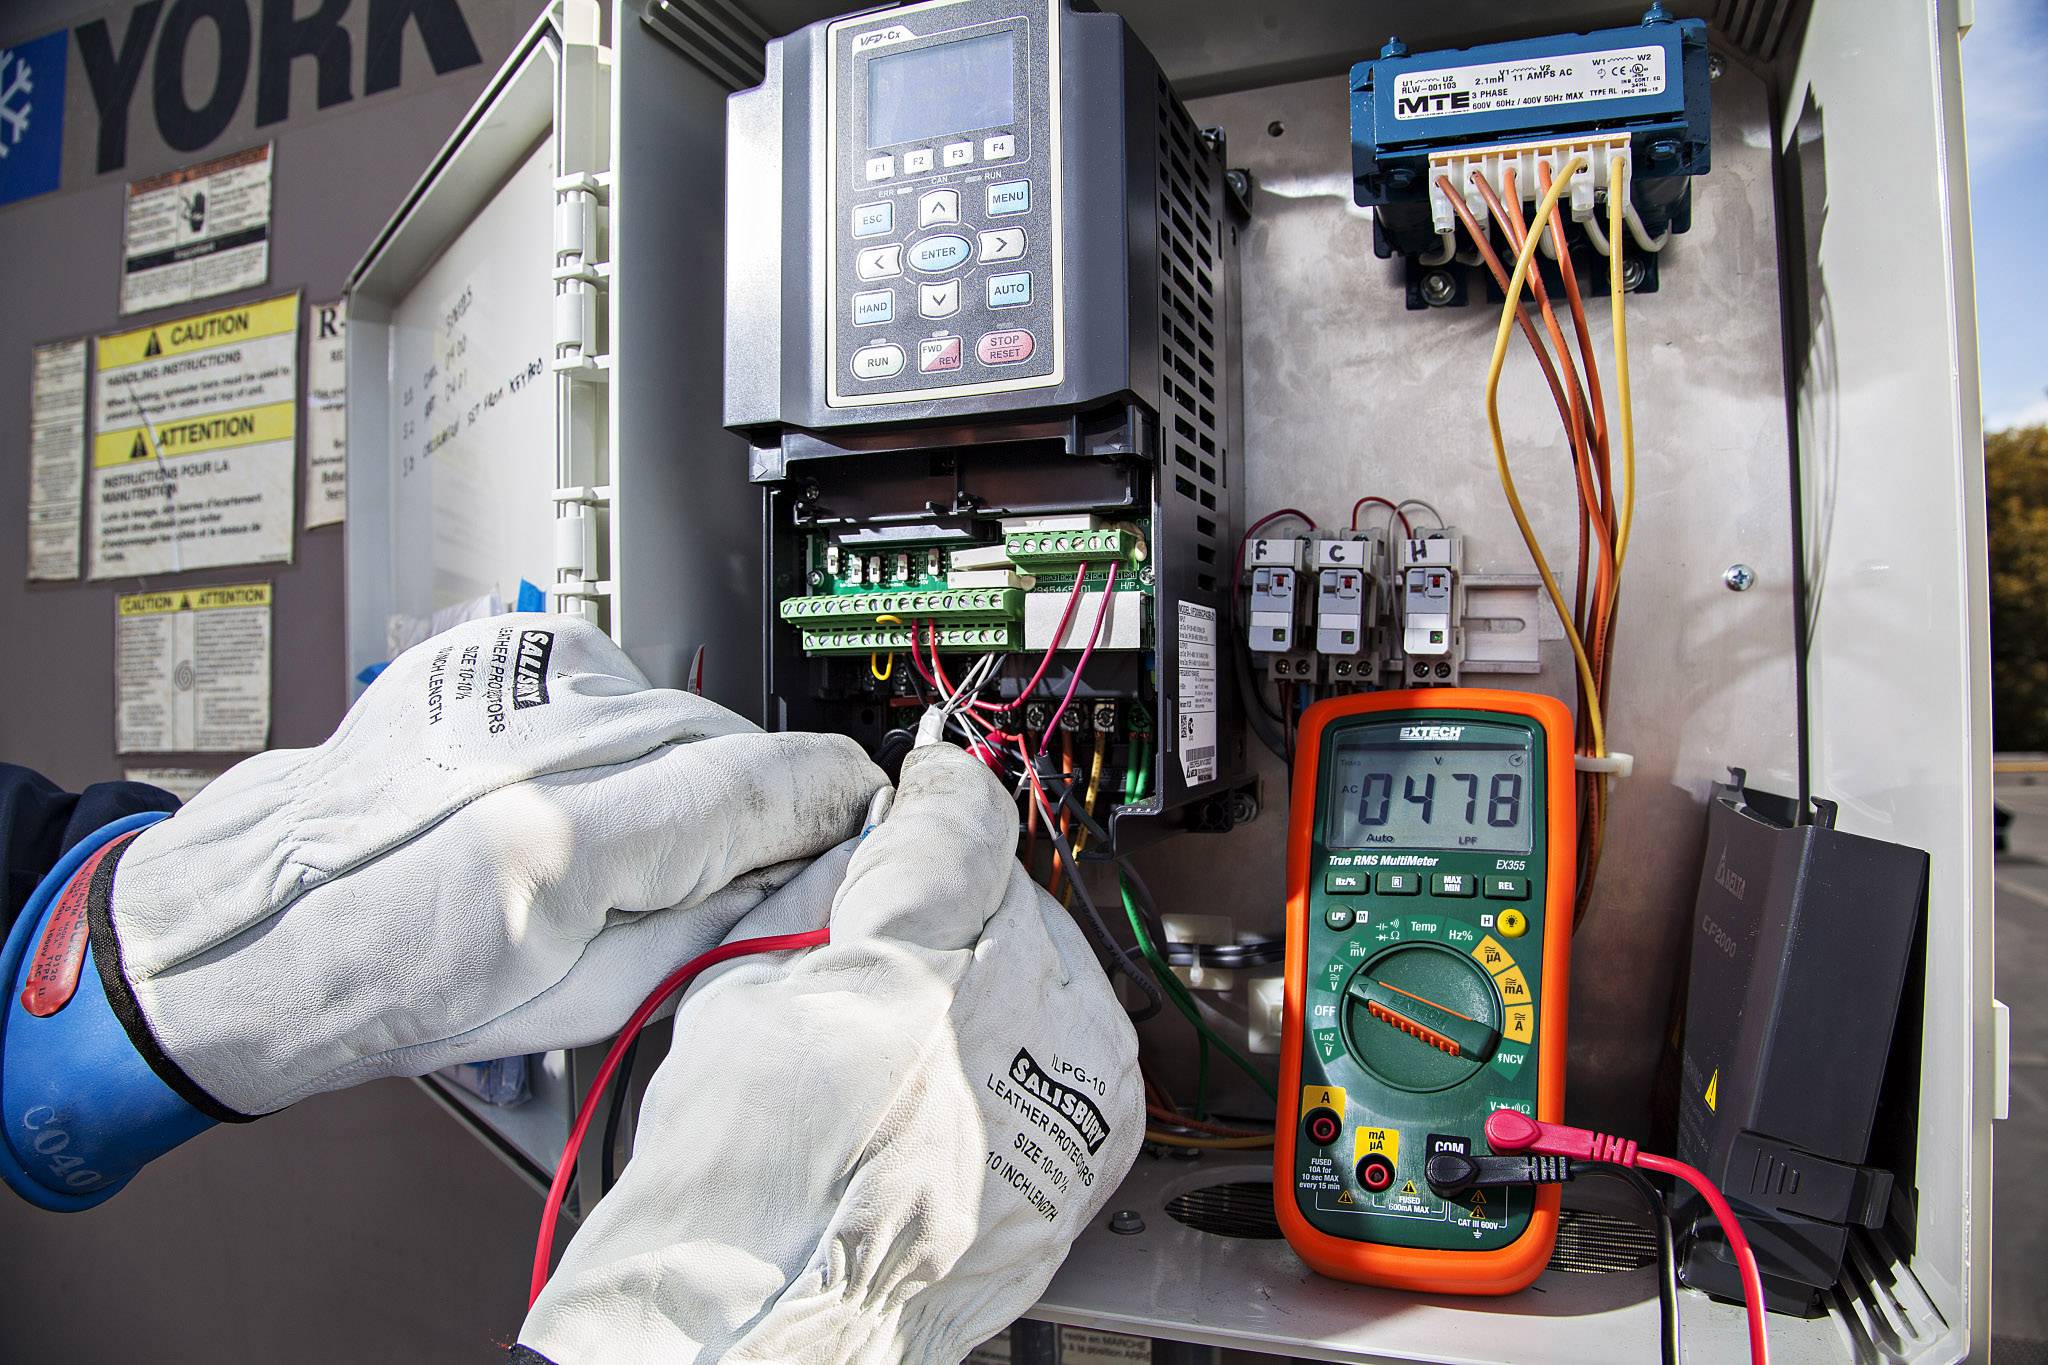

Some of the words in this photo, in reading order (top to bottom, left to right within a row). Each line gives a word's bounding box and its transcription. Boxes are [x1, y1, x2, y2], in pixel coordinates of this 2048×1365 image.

[1475, 76, 1504, 85] 2.1mH
[1527, 70, 1556, 80] AMPS
[1560, 68, 1573, 76] AC
[75, 0, 482, 175] YORK
[1480, 88, 1508, 98] PHASE
[1399, 91, 1470, 115] MTE
[1472, 101, 1491, 109] 600V
[1523, 96, 1542, 104] 400V
[1565, 92, 1584, 100] MAX
[993, 142, 1005, 152] F4
[952, 149, 964, 159] F3
[913, 156, 924, 165] F2
[875, 164, 885, 173] F1
[931, 176, 948, 184] CAN
[984, 172, 1001, 180] RUN
[878, 189, 894, 198] ERR
[992, 191, 1024, 204] MENU
[862, 214, 882, 225] ESC
[921, 246, 956, 260] ENTER
[994, 283, 1025, 296] AUTO
[859, 302, 888, 314] HAND
[170, 312, 249, 346] CAUTION
[990, 334, 1020, 347] STOP
[922, 344, 943, 353] FWD
[990, 348, 1020, 360] RESET
[162, 350, 241, 376] INSTRUCTIONS
[867, 357, 889, 368] RUN
[938, 356, 958, 366] REV
[157, 414, 255, 447] ATTENTION
[1252, 540, 1267, 560] F
[1329, 545, 1345, 563] C
[1411, 540, 1427, 562] H
[124, 597, 173, 612] CAUTION
[199, 588, 264, 605] ATTENTION
[461, 646, 479, 665] SIZE
[428, 674, 443, 725] LENGTH
[1400, 727, 1461, 737] EXTECH
[1434, 757, 1442, 766] V
[1341, 785, 1358, 794] AC
[1358, 773, 1522, 828] 0478
[1366, 834, 1394, 843] Auto
[1459, 836, 1478, 845] LPF
[1329, 855, 1351, 866] True
[1353, 856, 1378, 866] RMS
[1380, 856, 1439, 868] MultiMeter
[1496, 860, 1526, 871] EX355
[1335, 877, 1356, 887] Hz/%
[1443, 876, 1462, 885] MAX
[1498, 881, 1514, 891] REL
[1444, 884, 1461, 893] MIN
[1332, 911, 1346, 920] LPF
[1483, 916, 1491, 925] H
[1411, 921, 1437, 933] Temp
[1449, 930, 1473, 940] Hz%
[1350, 947, 1366, 956] mV
[42, 956, 54, 980] TYPE
[1329, 964, 1344, 972] LPF
[1331, 981, 1337, 990] V
[1505, 985, 1524, 994] mA
[1315, 1006, 1336, 1016] OFF
[1515, 1022, 1523, 1031] A
[1319, 1032, 1334, 1041] LoZ
[1325, 1046, 1332, 1056] V
[1503, 1053, 1524, 1064] NCV
[987, 1073, 1050, 1132] LEATHER
[1013, 1057, 1106, 1148] SALISBURY
[1321, 1091, 1331, 1104] A
[1368, 1130, 1386, 1141] mA
[1014, 1132, 1042, 1164] SIZE
[1435, 1141, 1464, 1154] COM
[1311, 1158, 1332, 1166] FUSED
[1324, 1174, 1339, 1182] MAX
[986, 1151, 1002, 1170] 10
[1000, 1162, 1030, 1195] INCH
[1027, 1185, 1058, 1222] LENGTH
[1399, 1196, 1421, 1205] FUSED
[1389, 1203, 1414, 1213] 600mA
[1414, 1204, 1429, 1214] MAX
[1457, 1219, 1472, 1227] CAT
[1481, 1221, 1499, 1230] 600V
